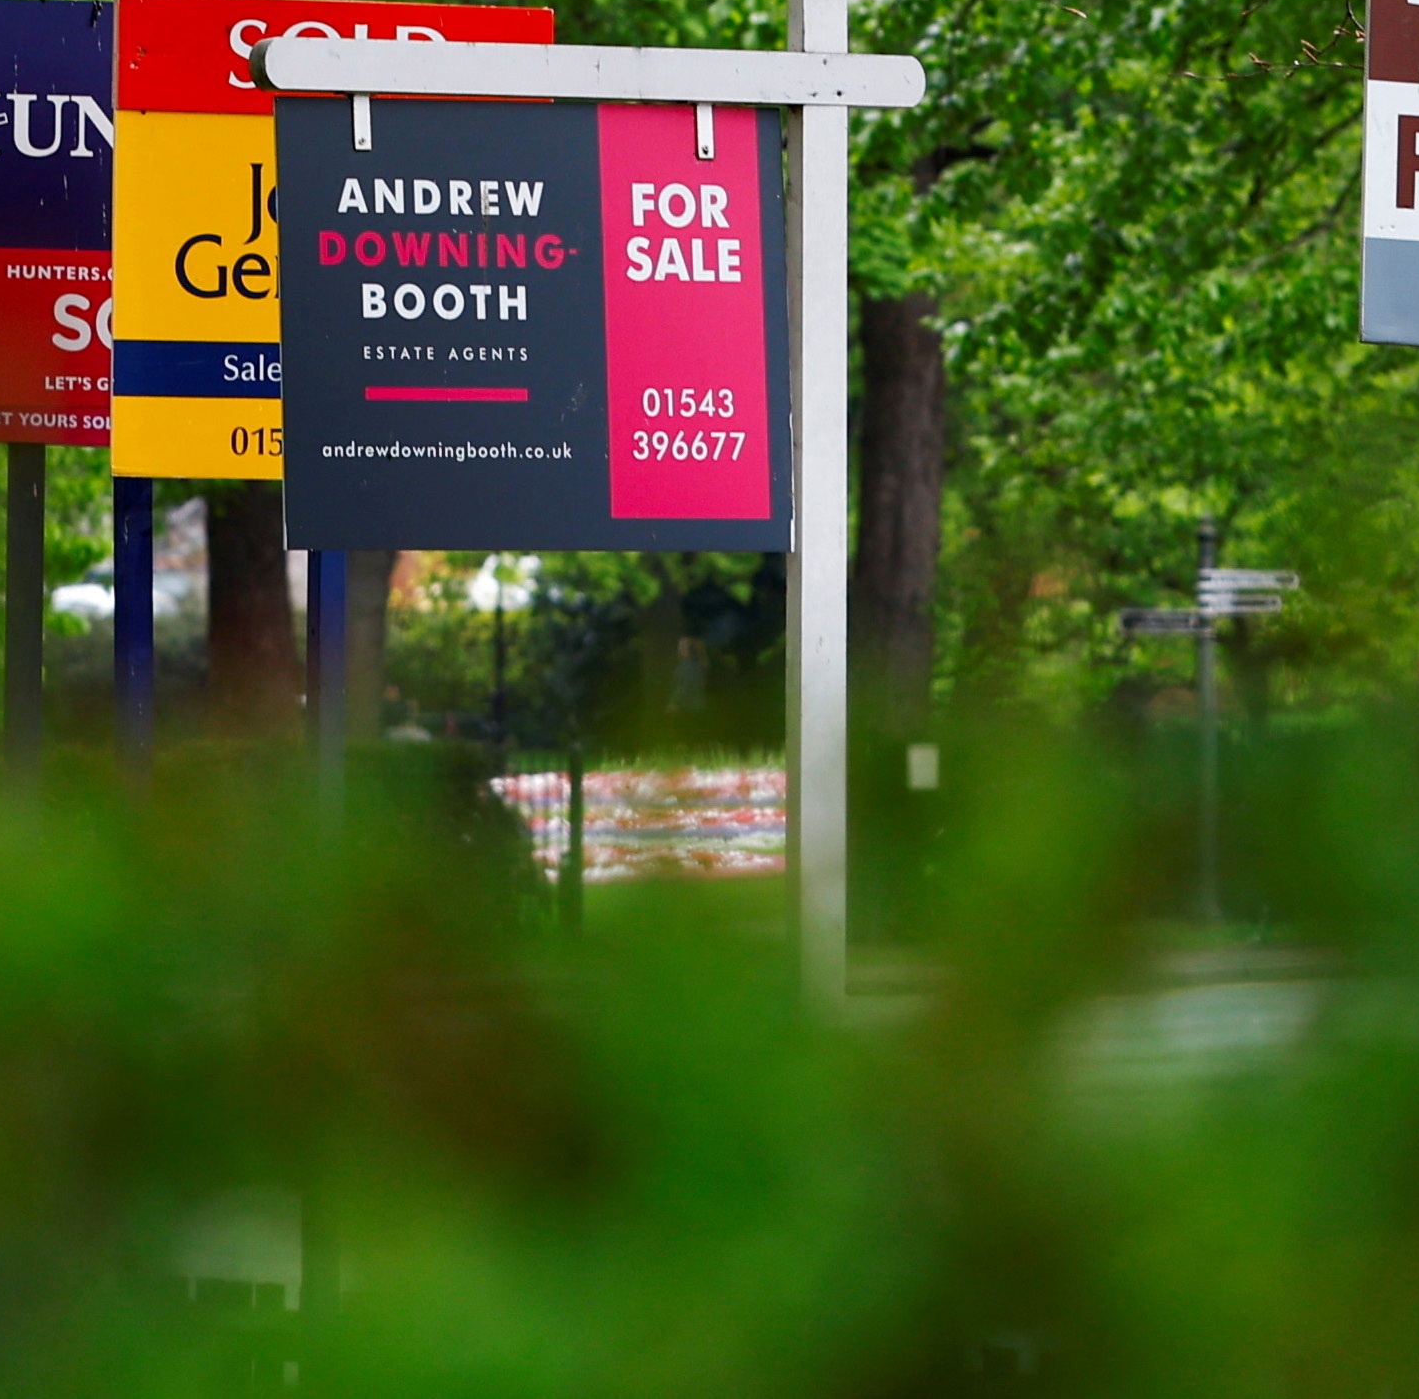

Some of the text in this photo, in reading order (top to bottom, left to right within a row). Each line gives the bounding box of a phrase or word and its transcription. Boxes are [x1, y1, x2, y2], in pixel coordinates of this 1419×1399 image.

[338, 178, 544, 217] ANDREW
[631, 183, 730, 229] FOR
[318, 230, 579, 270] DOWNING-
[625, 237, 742, 283] SALE
[7, 265, 113, 281] HUNTERS.
[361, 283, 529, 321] BOOTH
[363, 346, 529, 362] ESTATE AGENTS
[45, 376, 92, 391] LET'S
[642, 388, 735, 419] 01543
[18, 413, 78, 429] YOURS
[322, 441, 573, 463] andrewdowningbooth.co.uk
[632, 431, 747, 462] 396677
